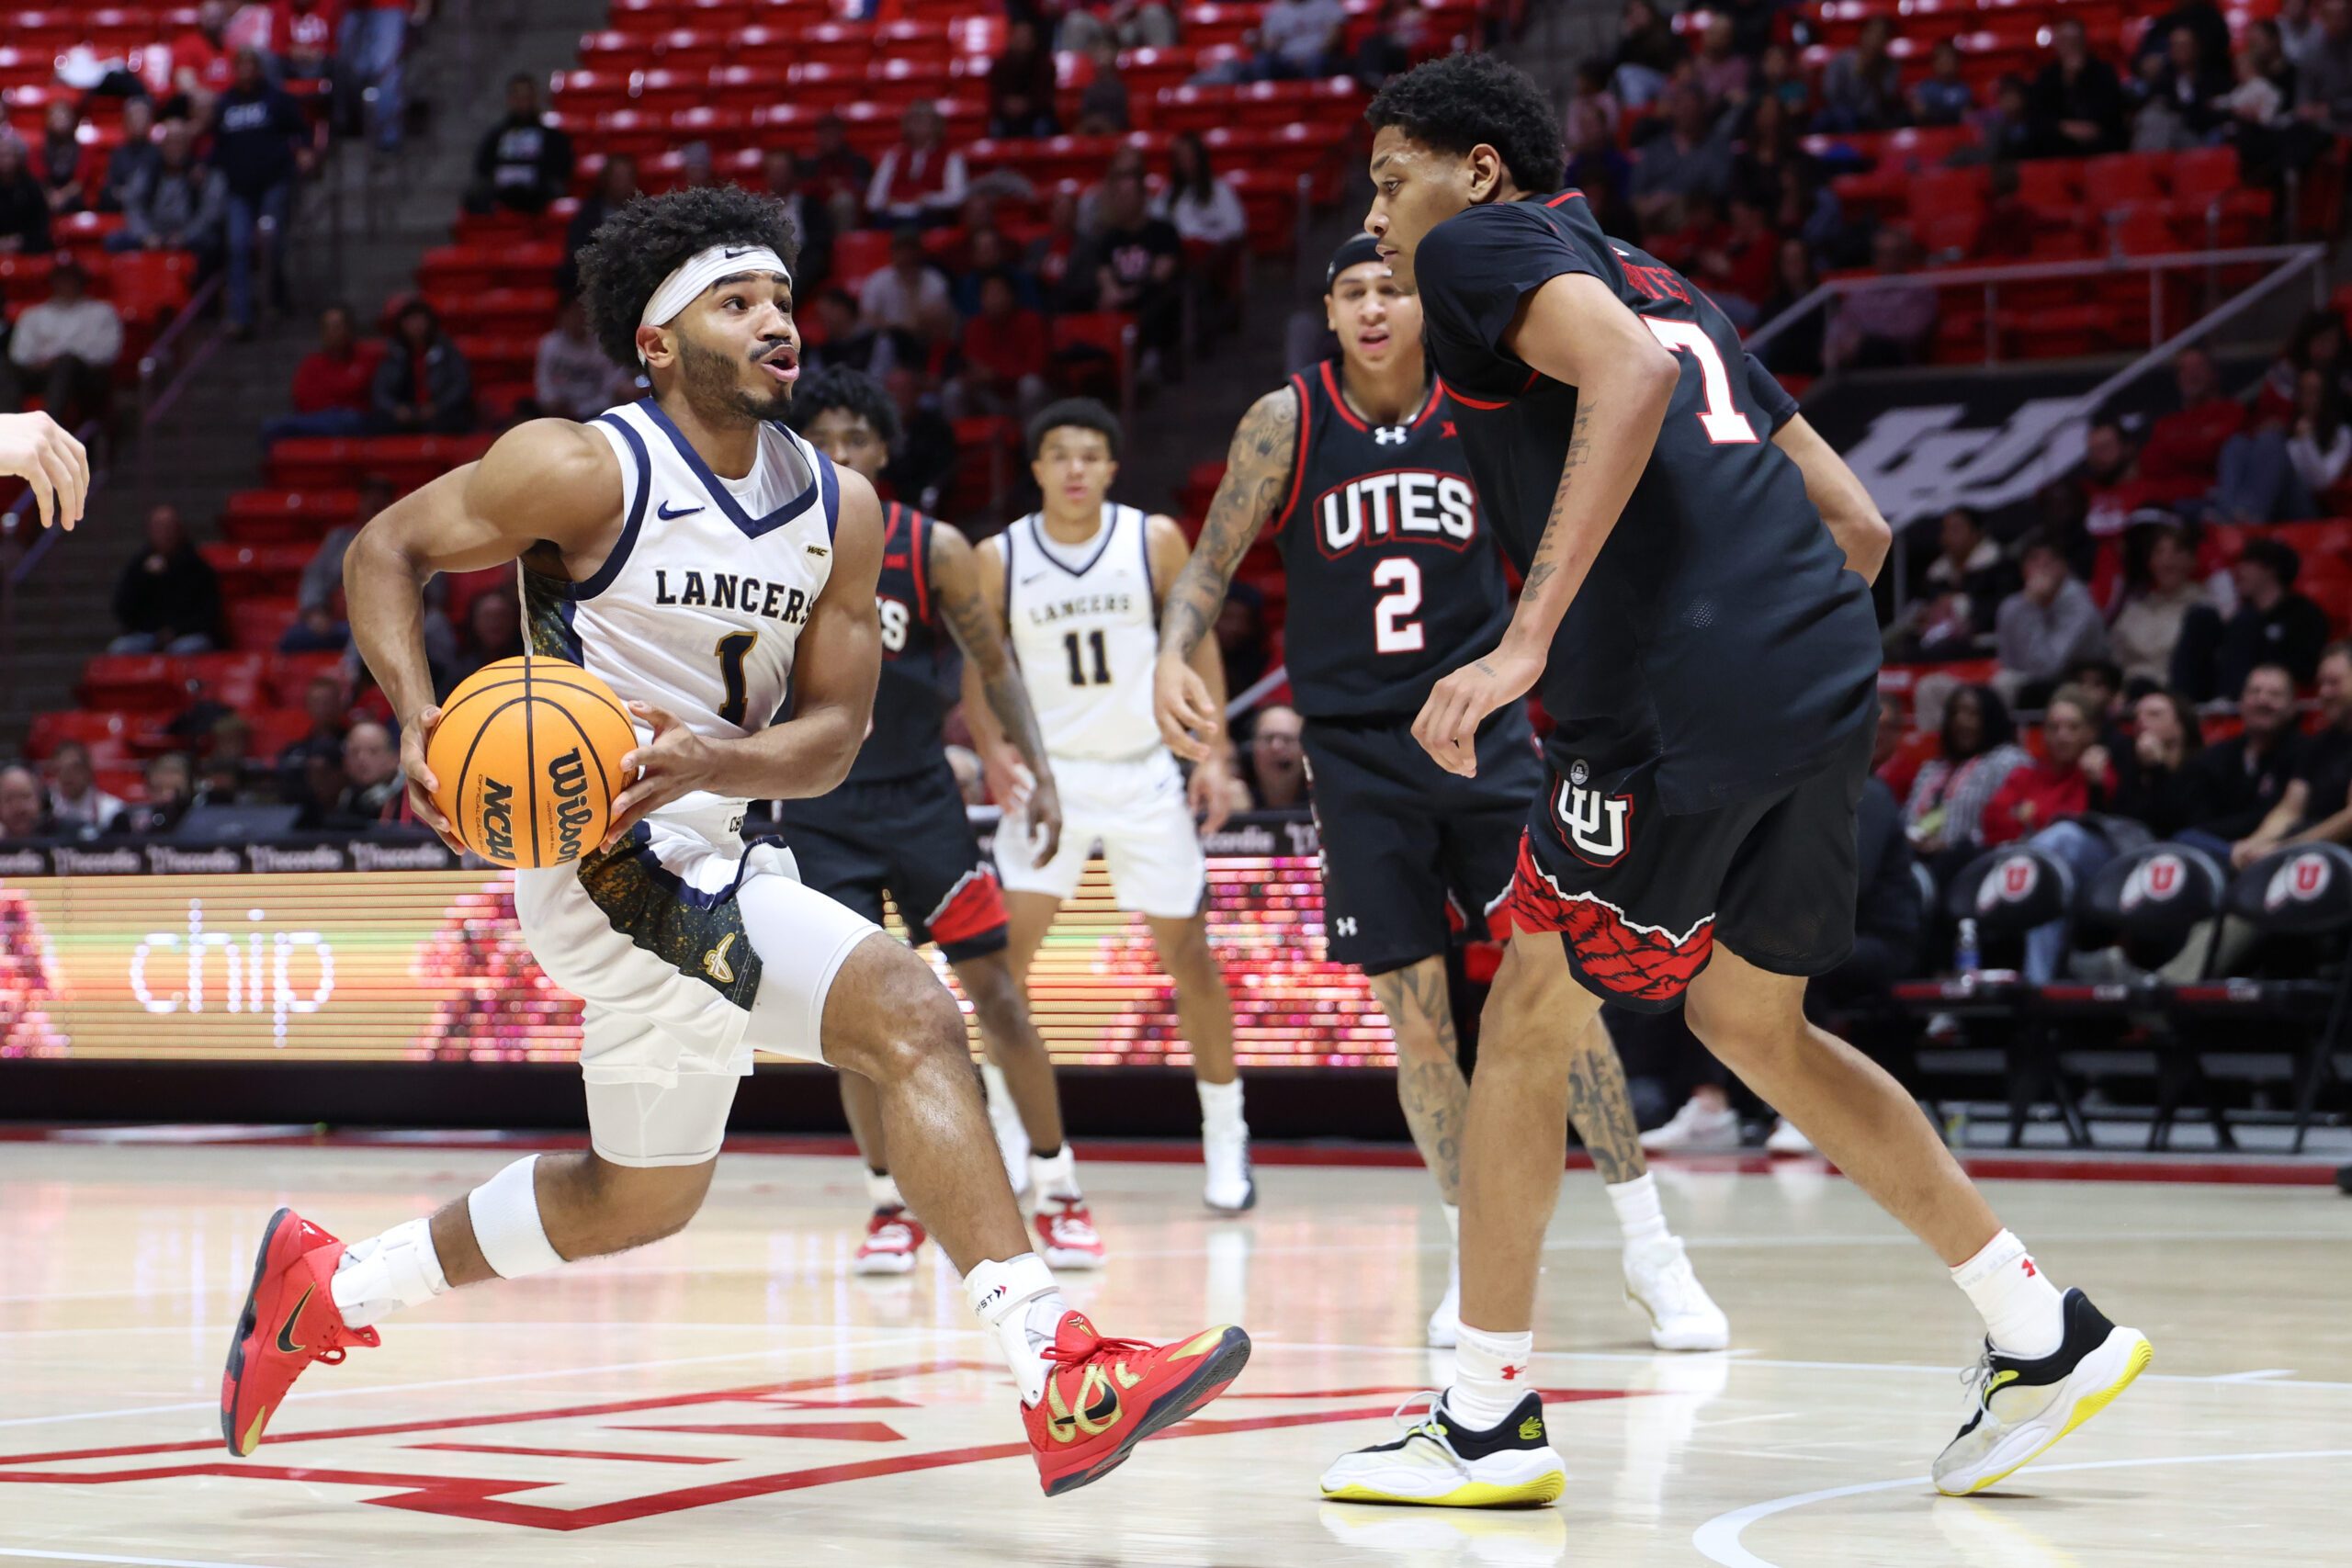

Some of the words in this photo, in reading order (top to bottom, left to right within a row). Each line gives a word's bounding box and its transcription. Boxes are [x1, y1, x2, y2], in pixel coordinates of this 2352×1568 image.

[1638, 313, 1760, 445] 7
[807, 545, 829, 557] WAC
[1317, 469, 1477, 555] UTES
[1029, 593, 1131, 625] LANCERS
[1374, 555, 1424, 653] 2
[714, 631, 758, 727] 1
[1063, 629, 1113, 686] 11
[483, 776, 517, 861] NCAA
[548, 747, 593, 865] Wilson
[130, 897, 334, 1048] chip
